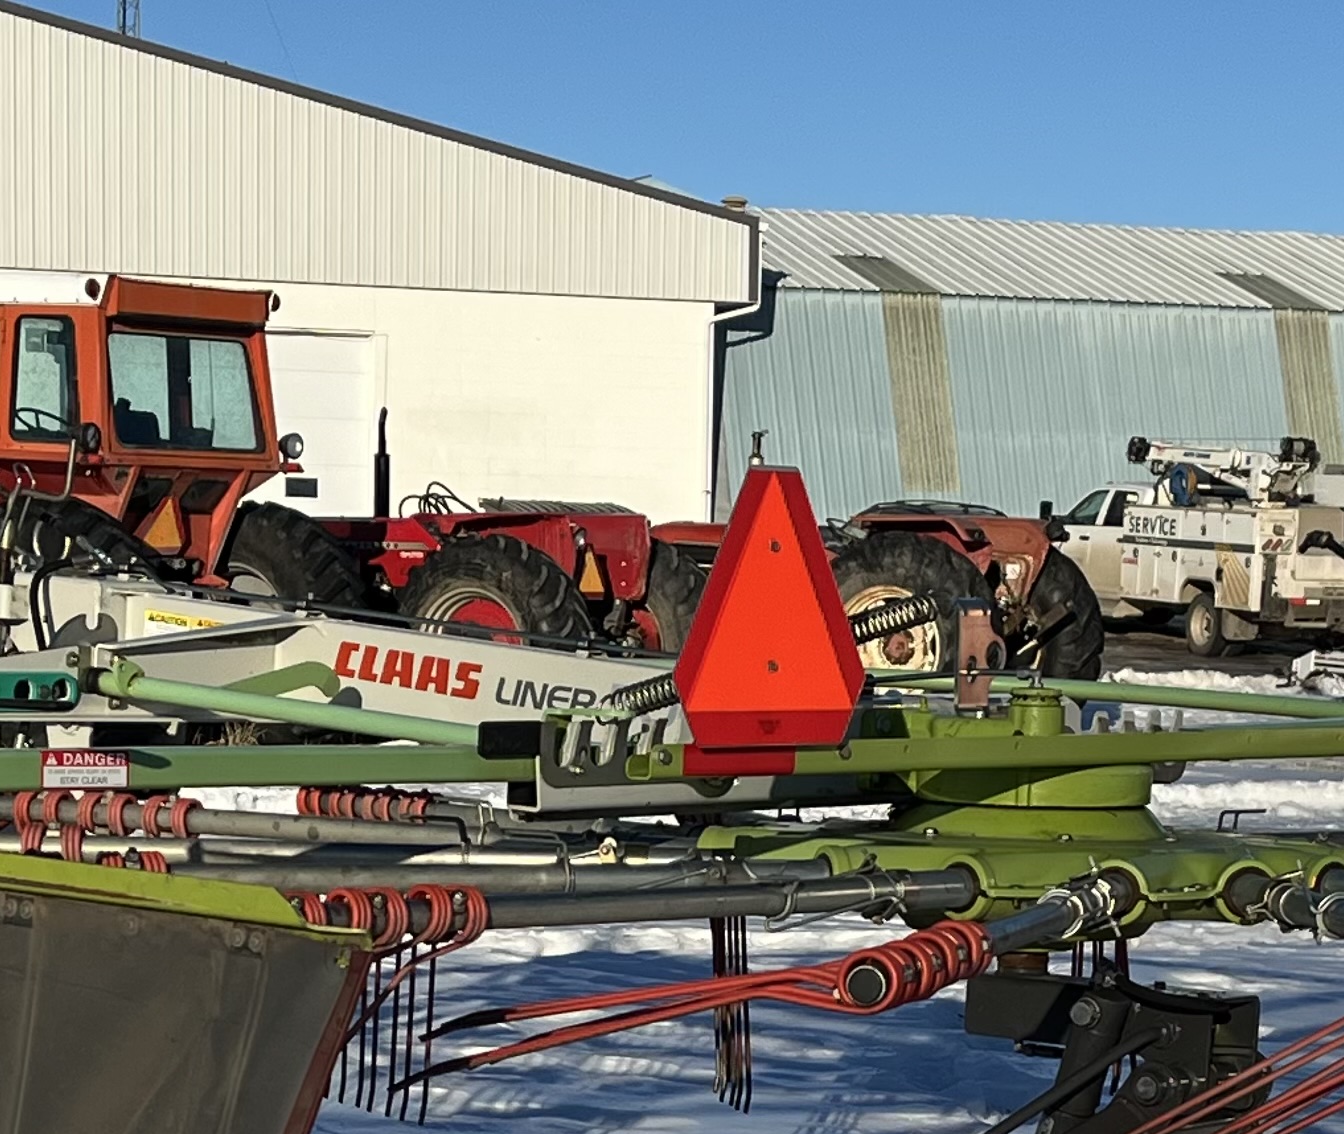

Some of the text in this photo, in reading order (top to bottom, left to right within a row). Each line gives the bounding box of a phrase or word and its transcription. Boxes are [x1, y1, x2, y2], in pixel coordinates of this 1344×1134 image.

[1128, 515, 1176, 536] SERVICE
[334, 640, 598, 711] CLAAS LINER
[62, 752, 126, 766] DANGER
[59, 776, 109, 785] STAY CLEAR
